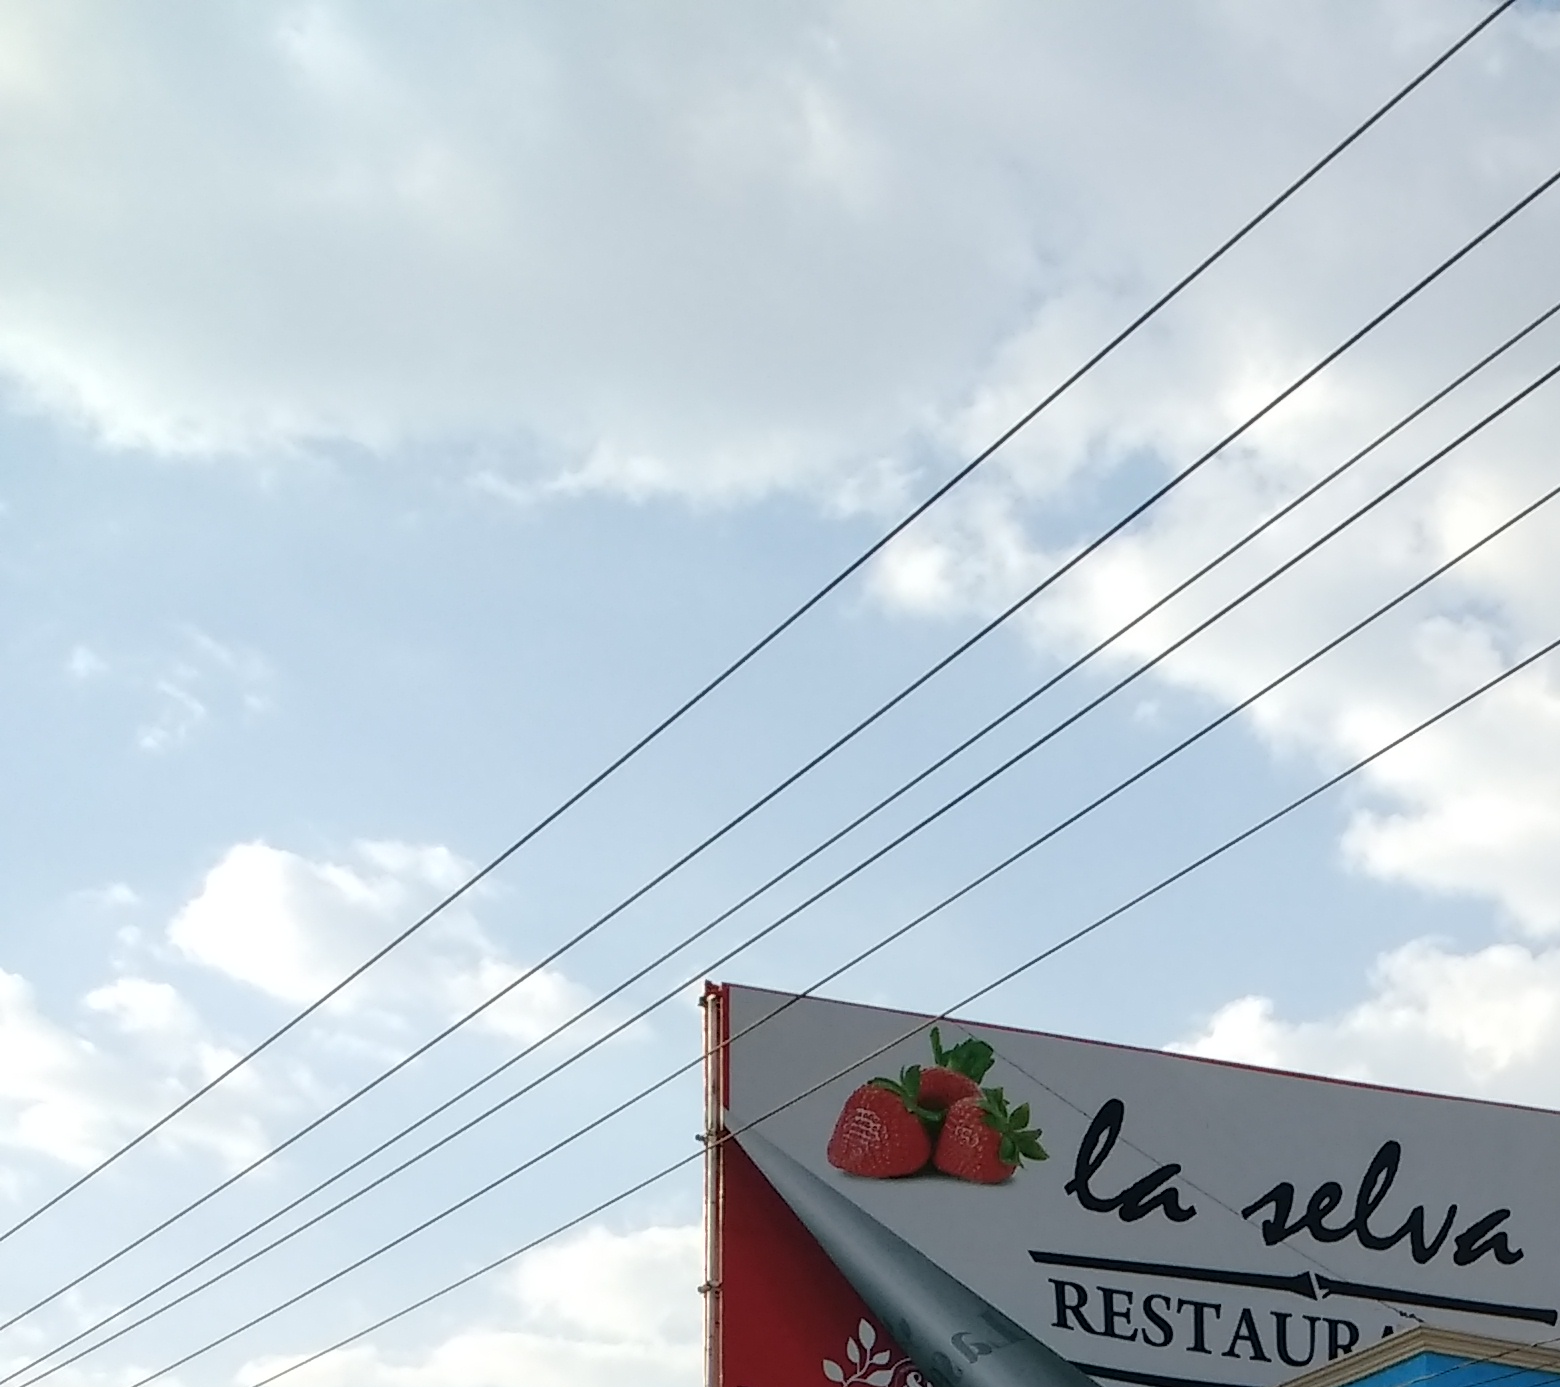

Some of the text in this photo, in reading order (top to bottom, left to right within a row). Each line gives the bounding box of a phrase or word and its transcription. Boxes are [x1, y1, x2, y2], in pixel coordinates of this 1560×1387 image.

[1065, 1097, 1525, 1268] la selva
[1047, 1277, 1396, 1369] RESTAUR
